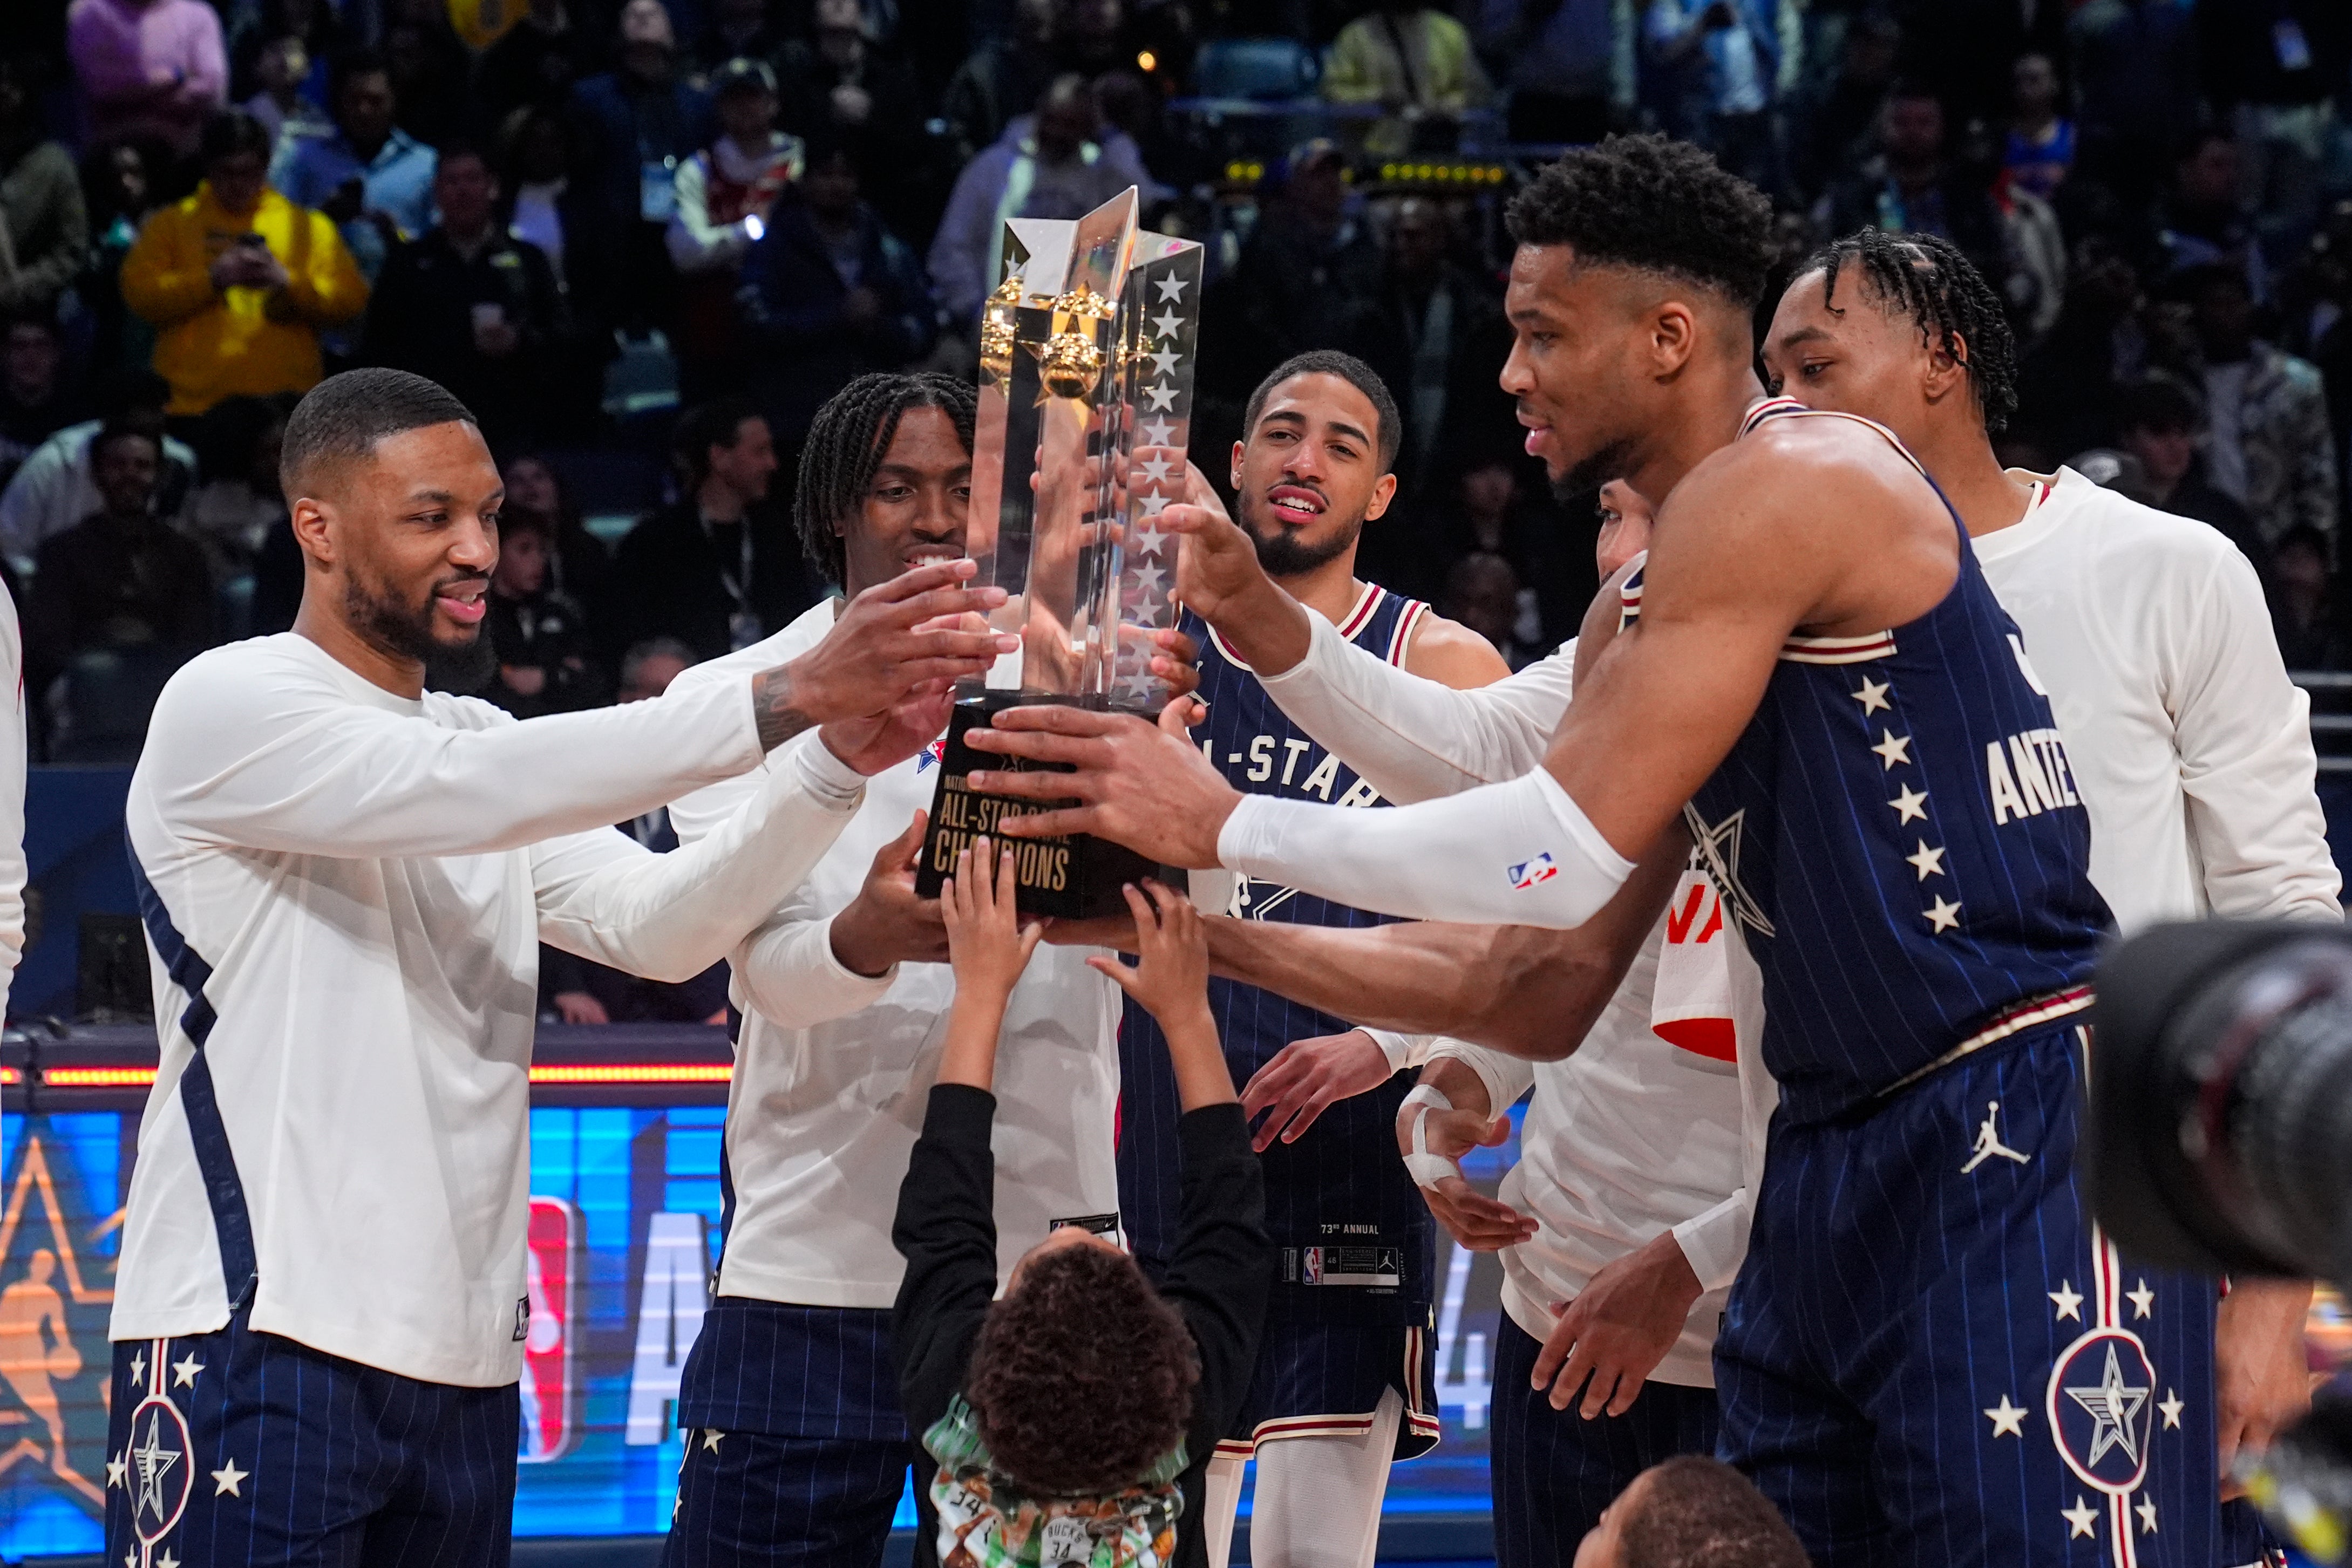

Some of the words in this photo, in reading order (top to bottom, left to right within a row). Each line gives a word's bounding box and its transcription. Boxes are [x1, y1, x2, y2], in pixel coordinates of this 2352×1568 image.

[1987, 727, 2086, 826] ANTE
[1343, 1224, 1379, 1235] ANNUAL
[1048, 1523, 1084, 1544] BUCKS
[1050, 1539, 1071, 1559] 34
